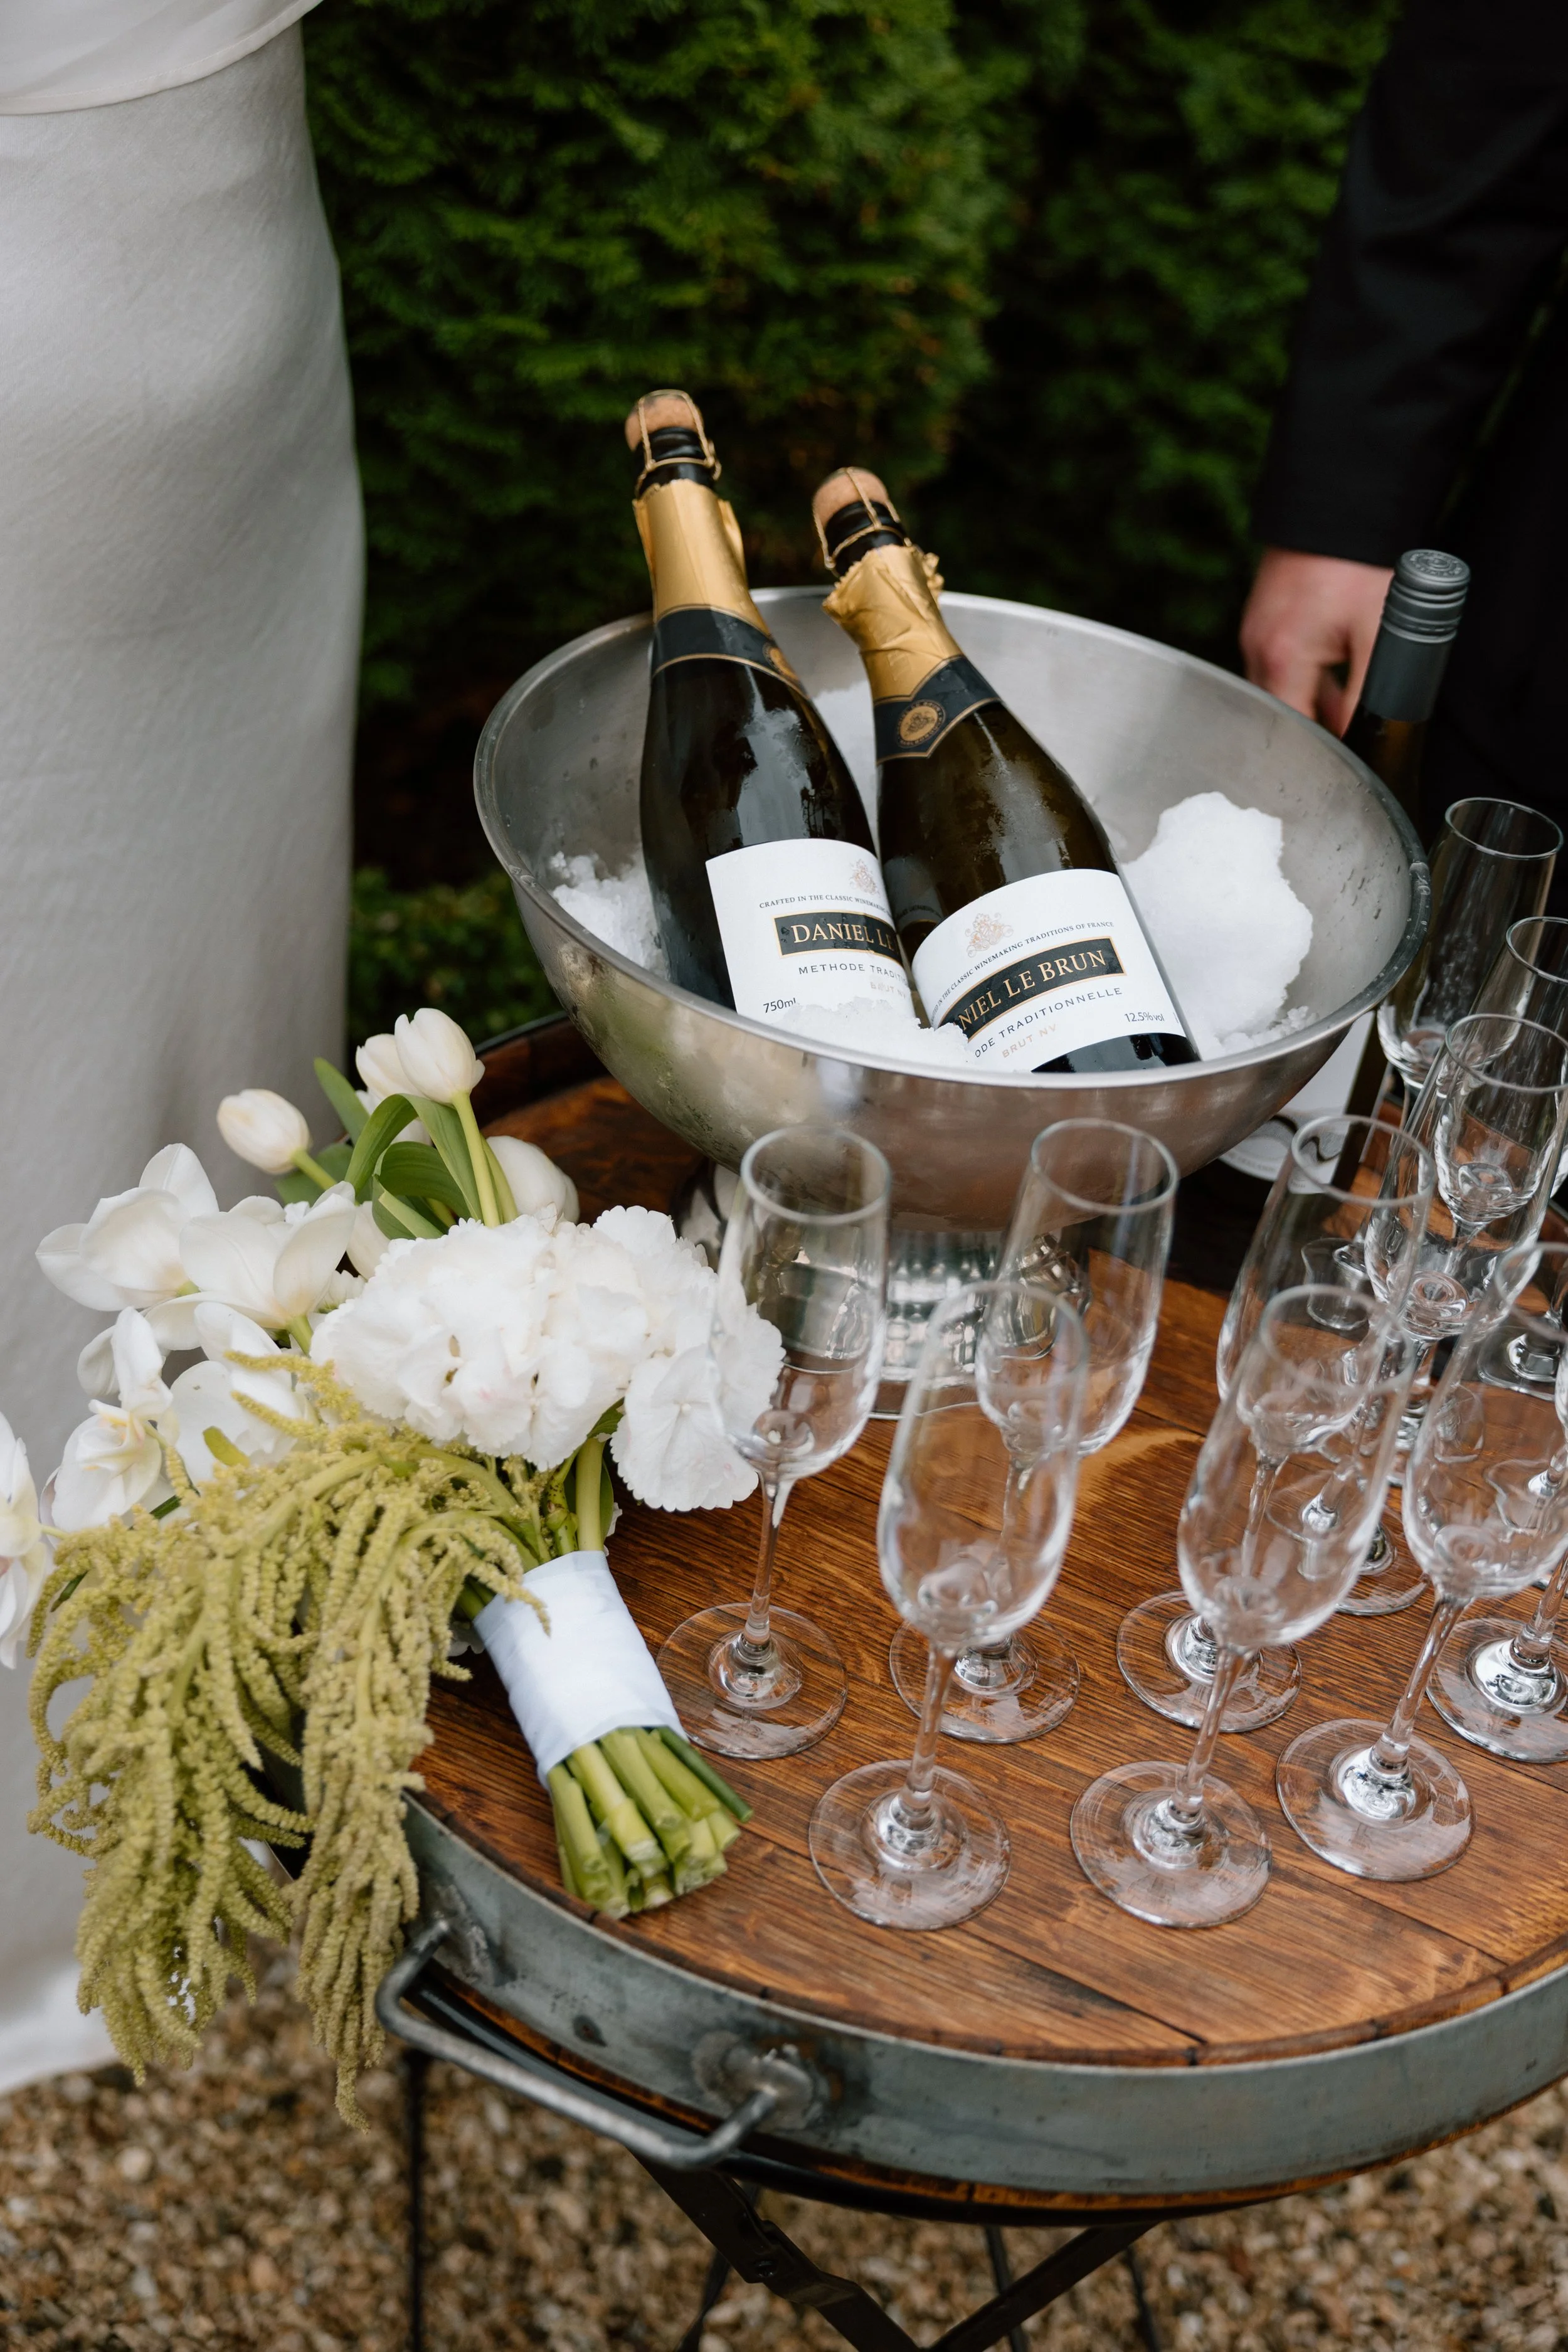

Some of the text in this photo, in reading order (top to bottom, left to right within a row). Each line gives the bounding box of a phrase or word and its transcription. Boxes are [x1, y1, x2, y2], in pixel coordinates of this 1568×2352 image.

[760, 897, 795, 908] CRAFTED
[790, 923, 874, 943] DANIEL
[798, 963, 865, 975] METHODE
[942, 988, 951, 1000] THE
[951, 968, 973, 990] CLASSIC
[974, 941, 1024, 971] WINEMAKING
[1024, 926, 1074, 944] TRADITIONS
[1003, 970, 1036, 998] LE
[1037, 950, 1106, 982] BRUN
[763, 997, 796, 1014] 750ml
[999, 987, 1123, 1038] TRADITIONNELLE
[1002, 1024, 1056, 1058] BRUT NV
